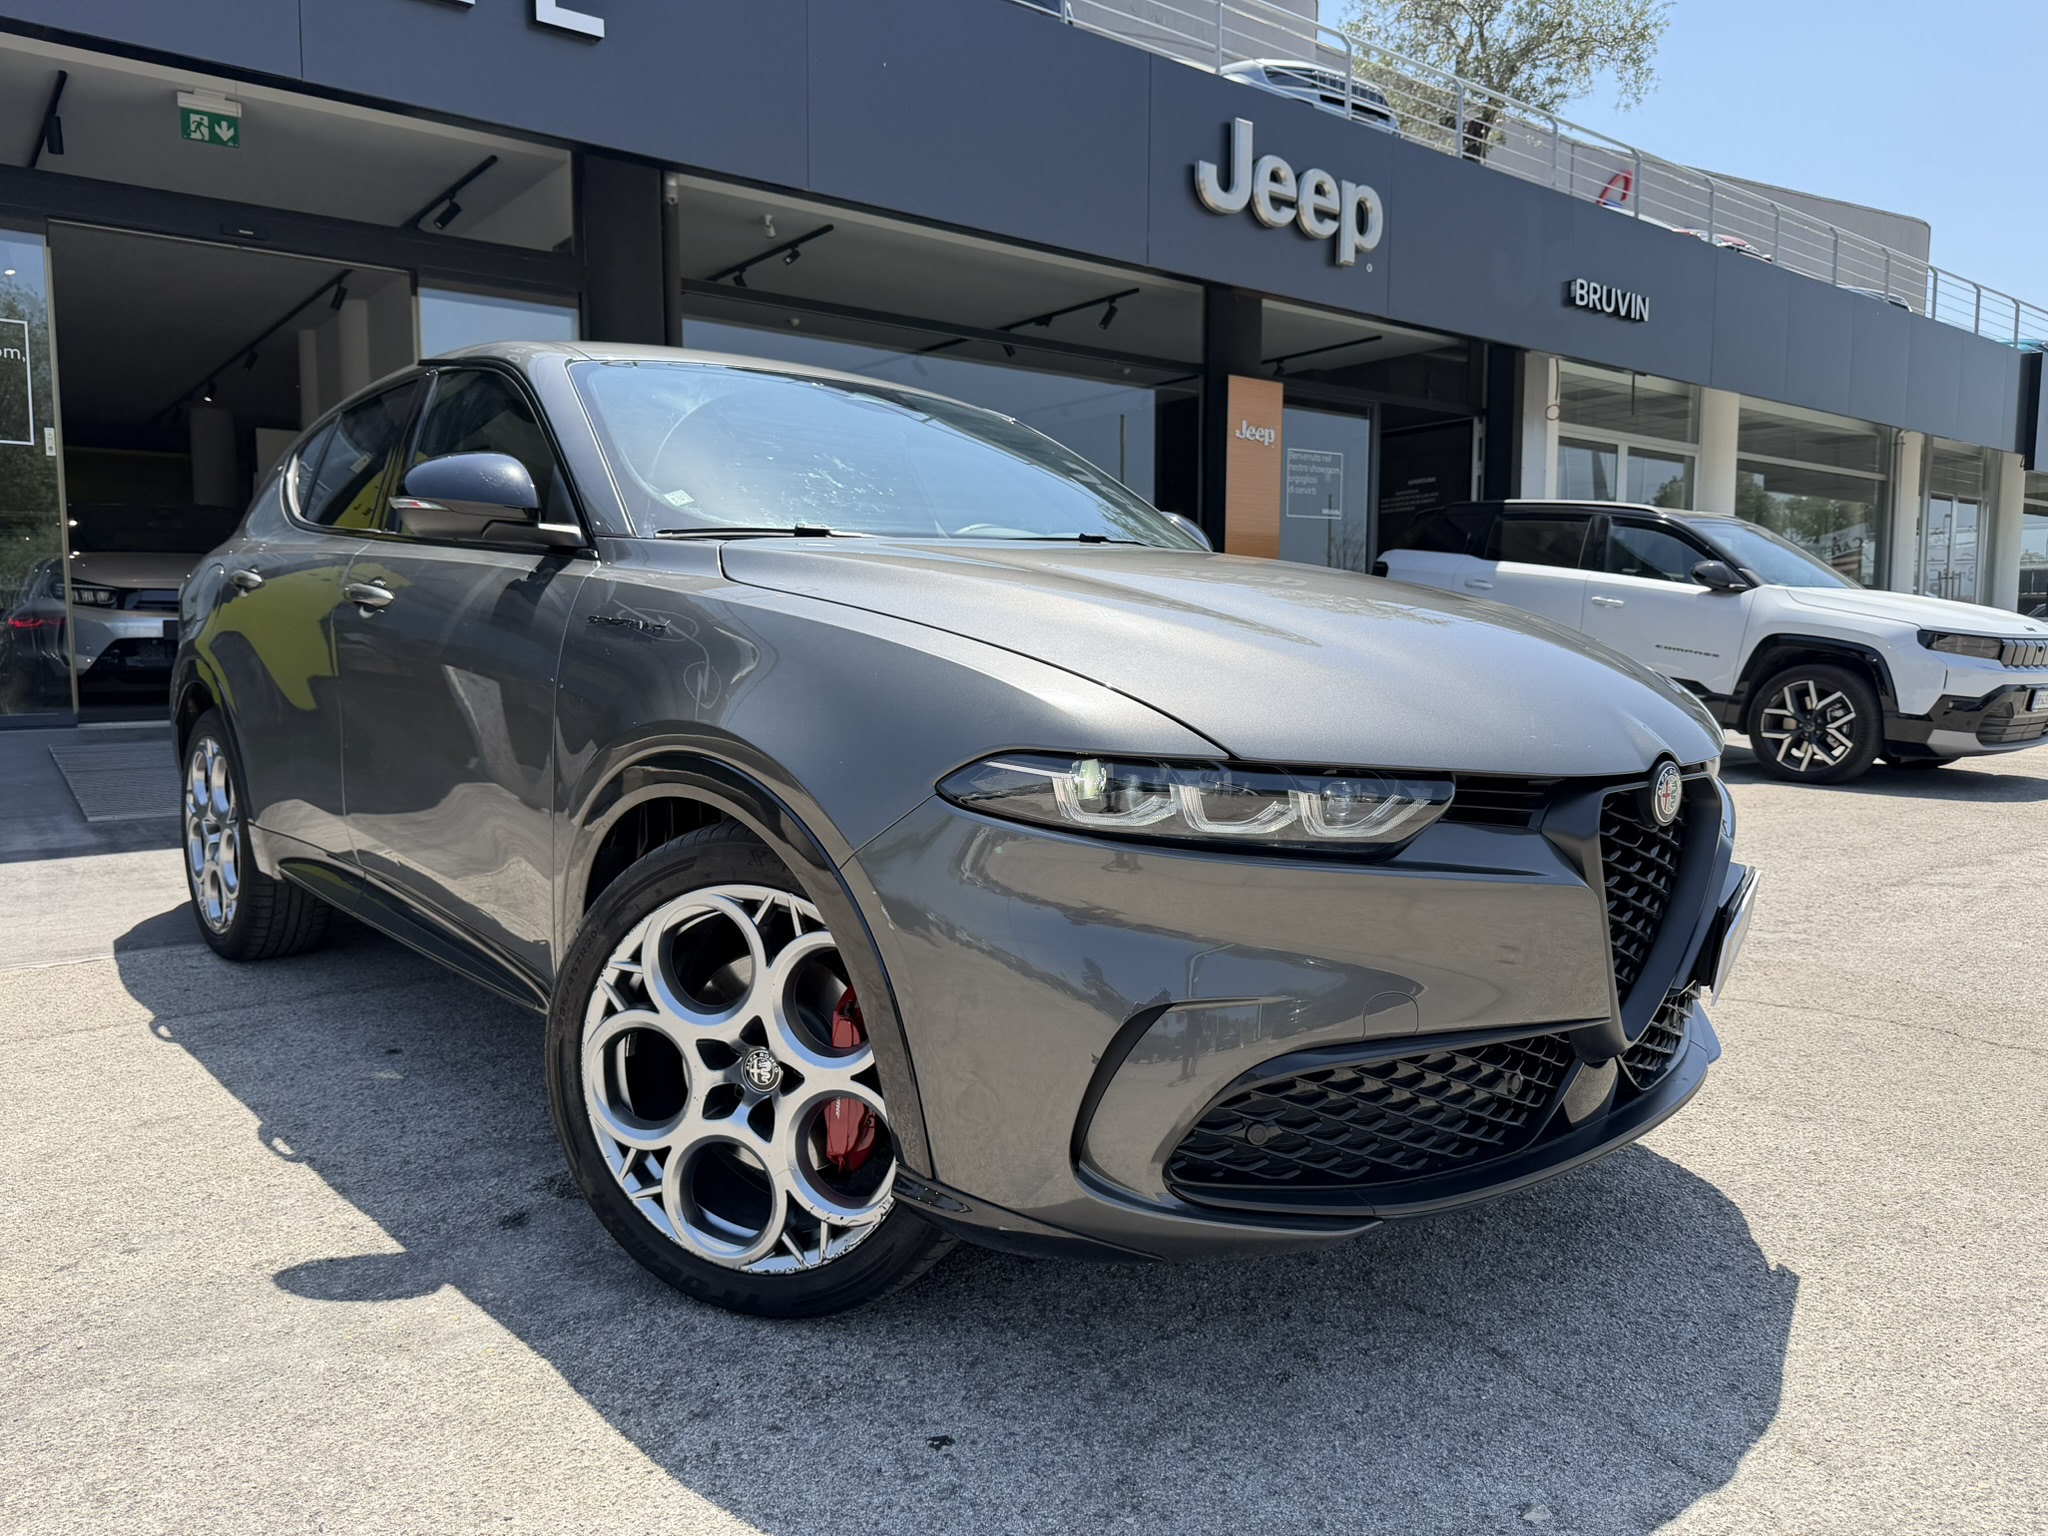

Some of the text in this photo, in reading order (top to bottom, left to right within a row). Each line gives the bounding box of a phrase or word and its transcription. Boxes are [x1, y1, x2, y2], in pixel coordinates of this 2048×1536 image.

[1194, 117, 1384, 266] Jeep
[1574, 277, 1650, 322] BRUVIN
[1235, 420, 1275, 446] Jeep
[1288, 452, 1321, 462] Benvenuto
[1288, 464, 1308, 472] nostro
[1654, 643, 1721, 658] COMPASS
[759, 1052, 779, 1073] ROMEO
